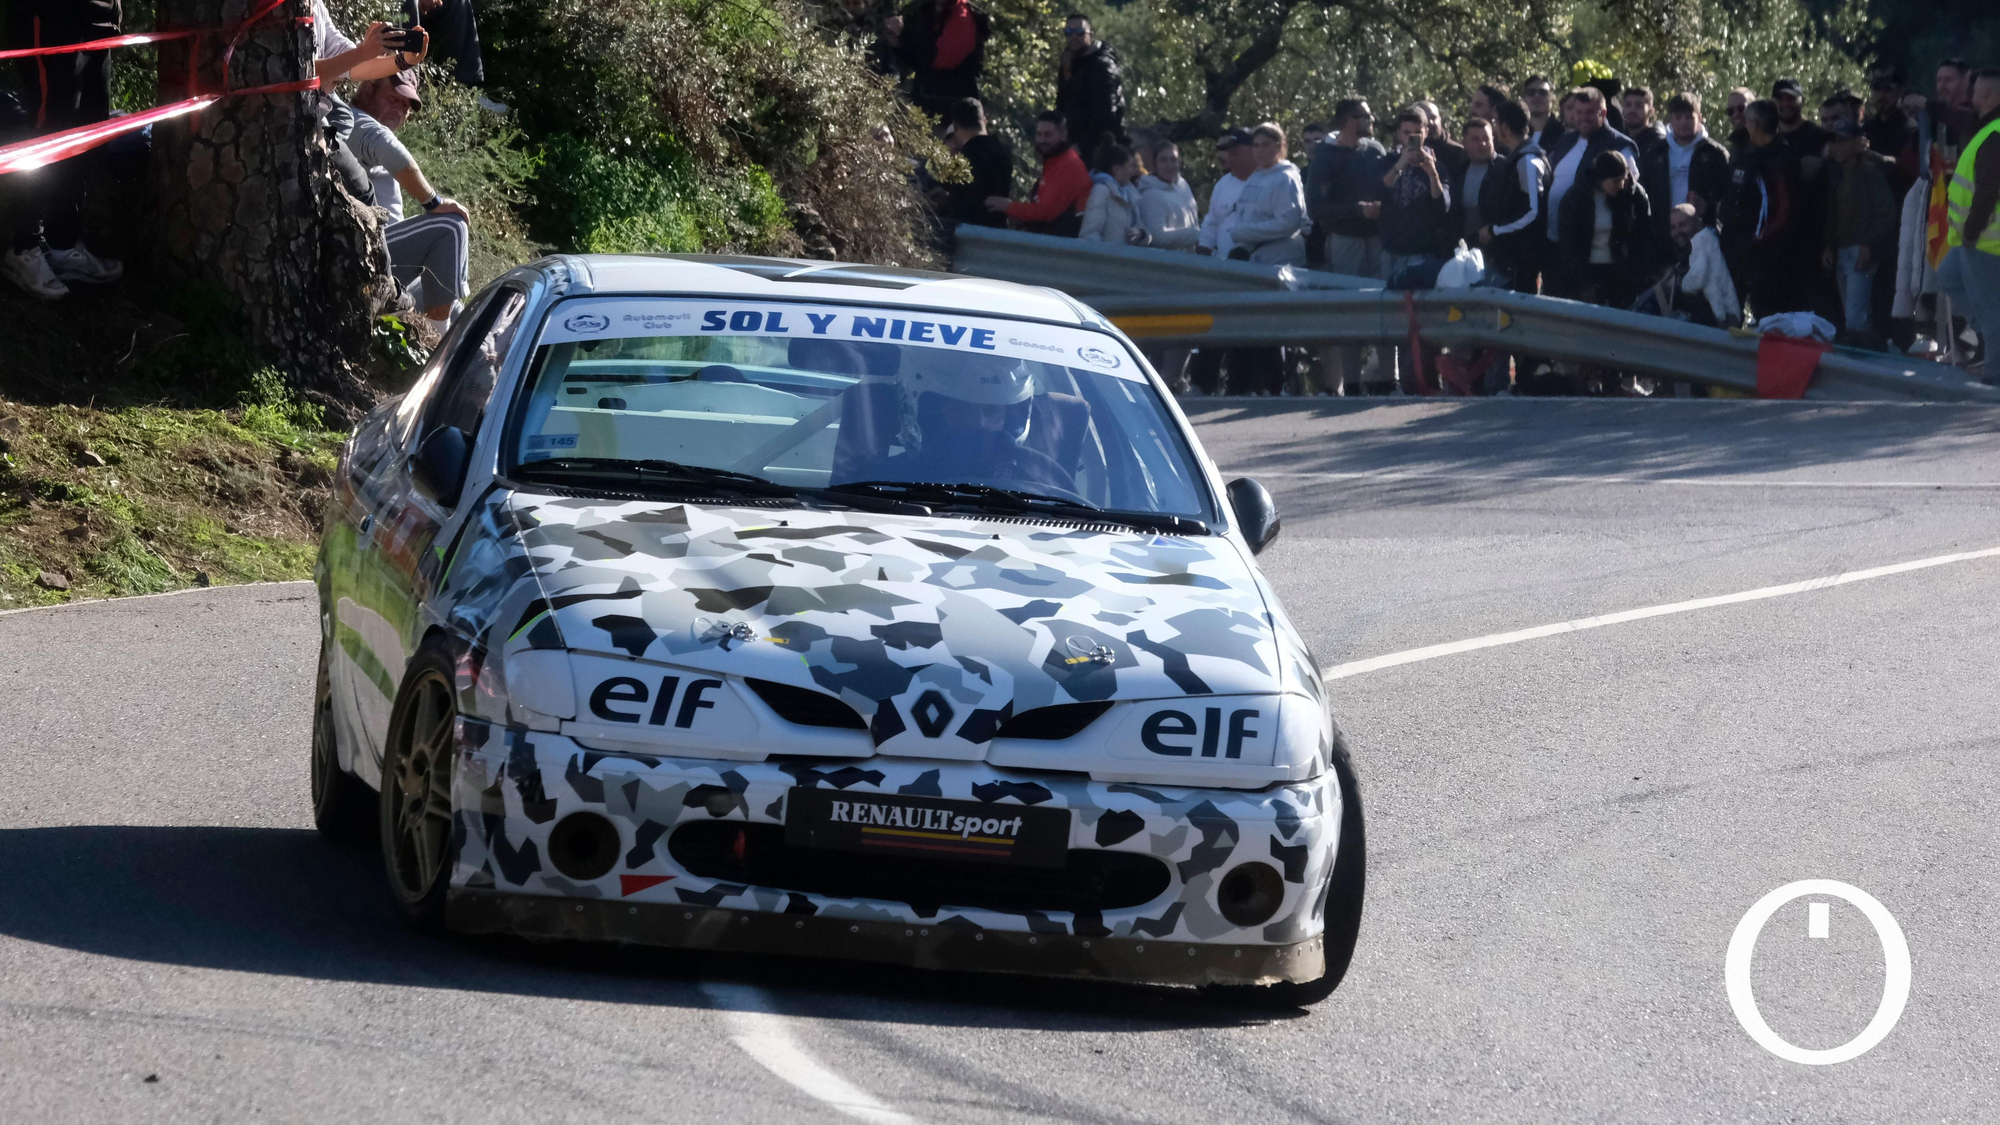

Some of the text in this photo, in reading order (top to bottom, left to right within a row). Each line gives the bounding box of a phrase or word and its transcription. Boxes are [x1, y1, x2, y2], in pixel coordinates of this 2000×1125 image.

[642, 321, 673, 330] Club
[700, 309, 996, 351] SOL Y NIEVE
[1008, 337, 1065, 354] Granada
[549, 436, 575, 446] 145
[589, 675, 723, 729] elf
[1140, 706, 1260, 759] elf
